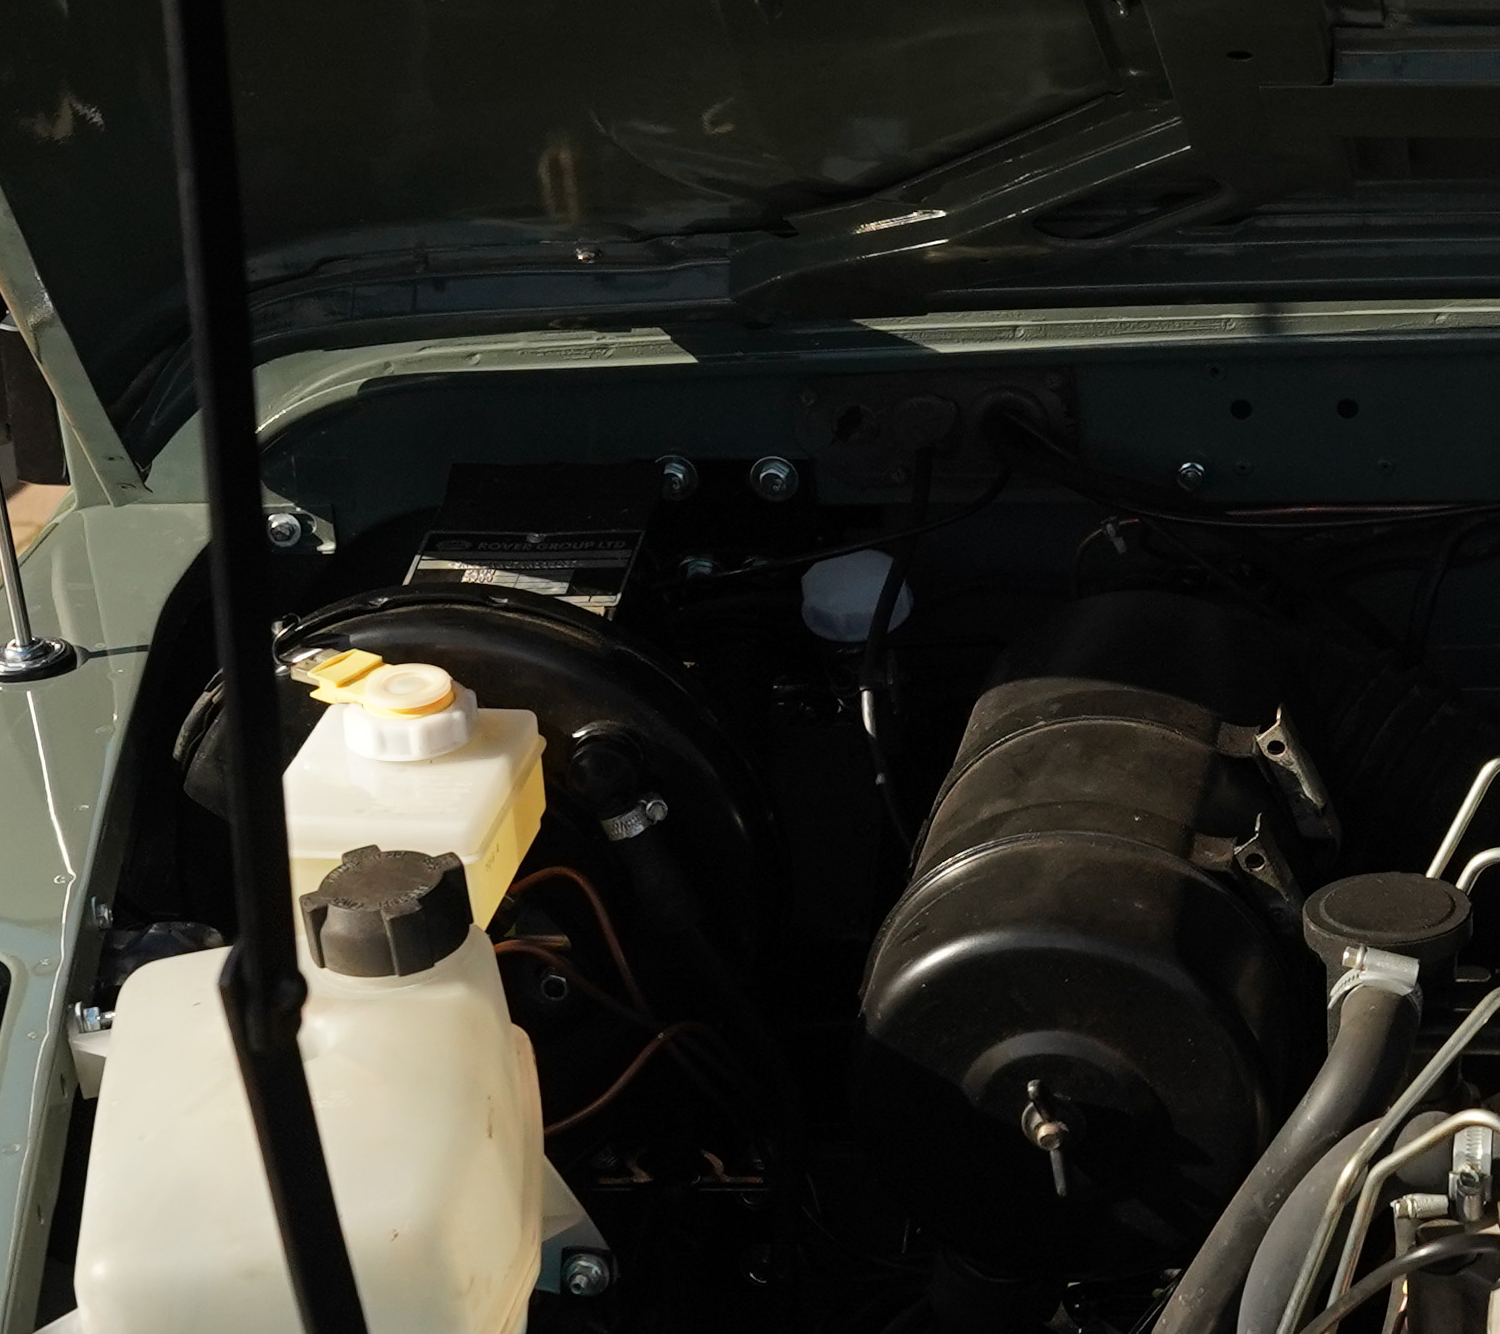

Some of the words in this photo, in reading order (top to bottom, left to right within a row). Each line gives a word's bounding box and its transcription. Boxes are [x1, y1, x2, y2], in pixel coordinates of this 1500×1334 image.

[477, 541, 534, 551] ROVER
[536, 540, 595, 551] GROUP
[597, 539, 628, 550] LTD
